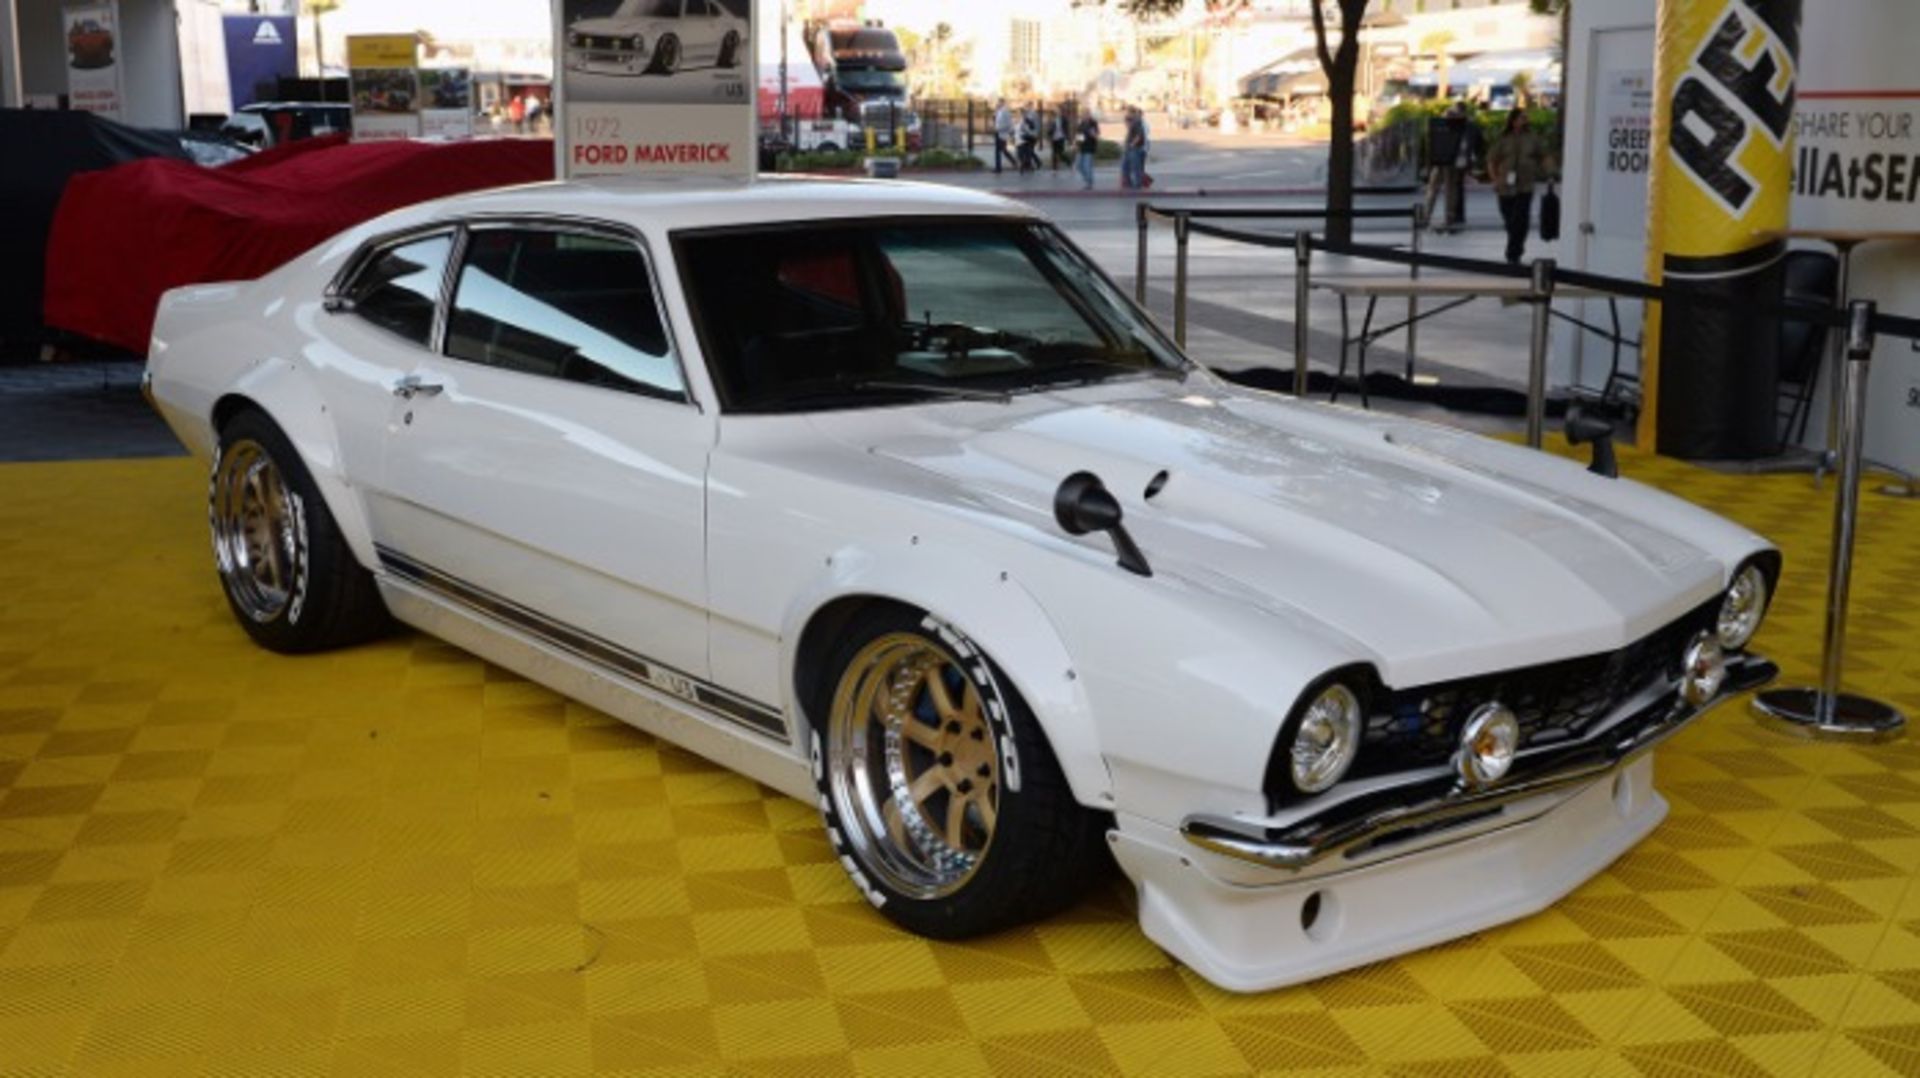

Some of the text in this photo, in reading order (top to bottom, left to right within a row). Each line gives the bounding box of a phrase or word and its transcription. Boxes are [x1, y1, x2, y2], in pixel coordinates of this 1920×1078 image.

[575, 116, 620, 138] 1972
[1857, 111, 1912, 138] YOUR
[574, 143, 730, 164] FORD MAVERICK
